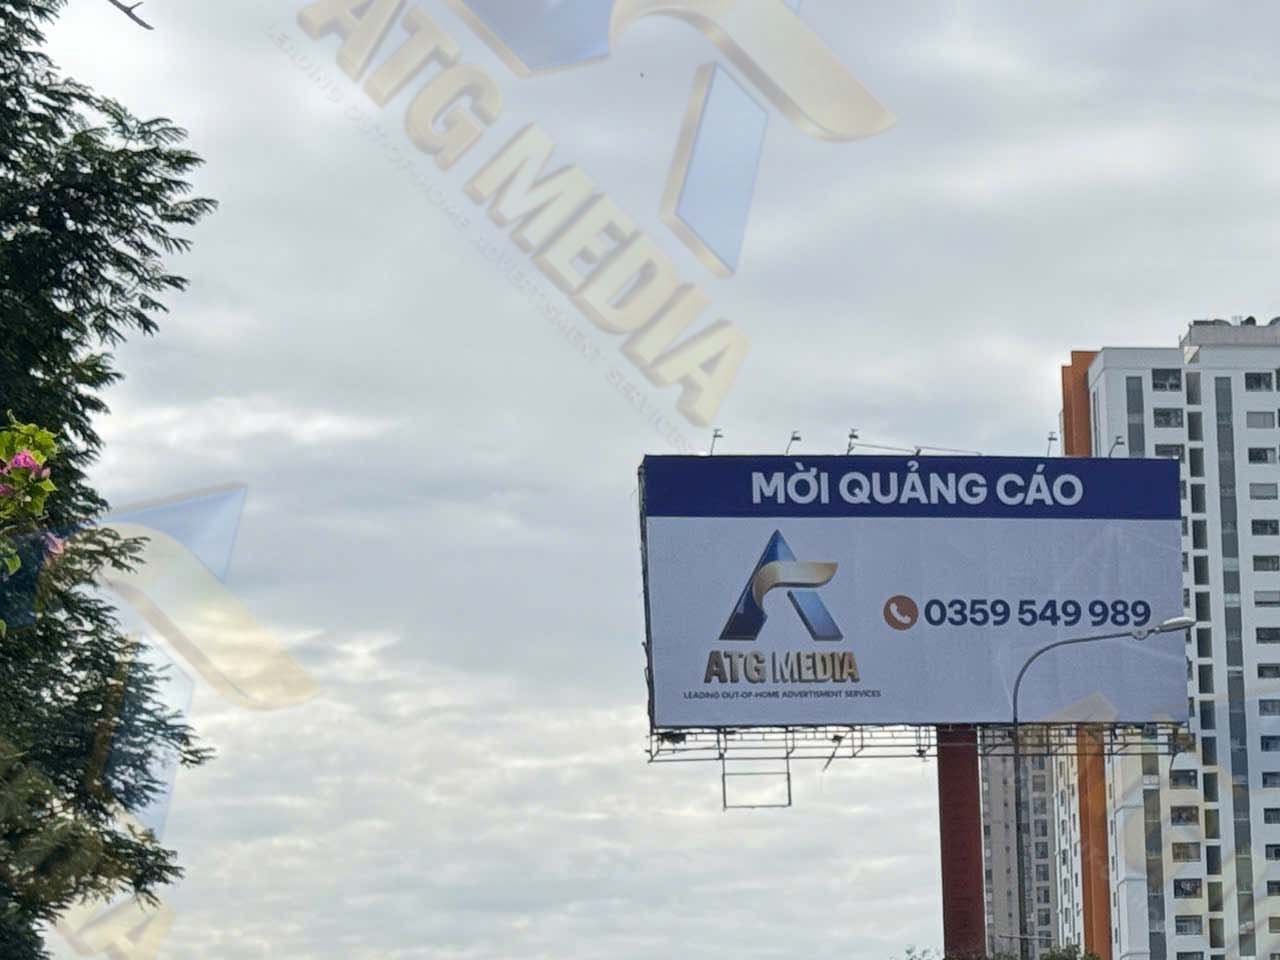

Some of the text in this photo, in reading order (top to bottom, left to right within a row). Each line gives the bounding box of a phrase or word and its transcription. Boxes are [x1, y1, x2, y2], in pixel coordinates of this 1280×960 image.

[752, 460, 1084, 506] MỜI QUẢNG CÁO
[924, 599, 1150, 628] 0359 549 989
[704, 650, 860, 684] ATG MEDIA
[684, 691, 719, 700] LEADING
[845, 689, 881, 699] SERVICES
